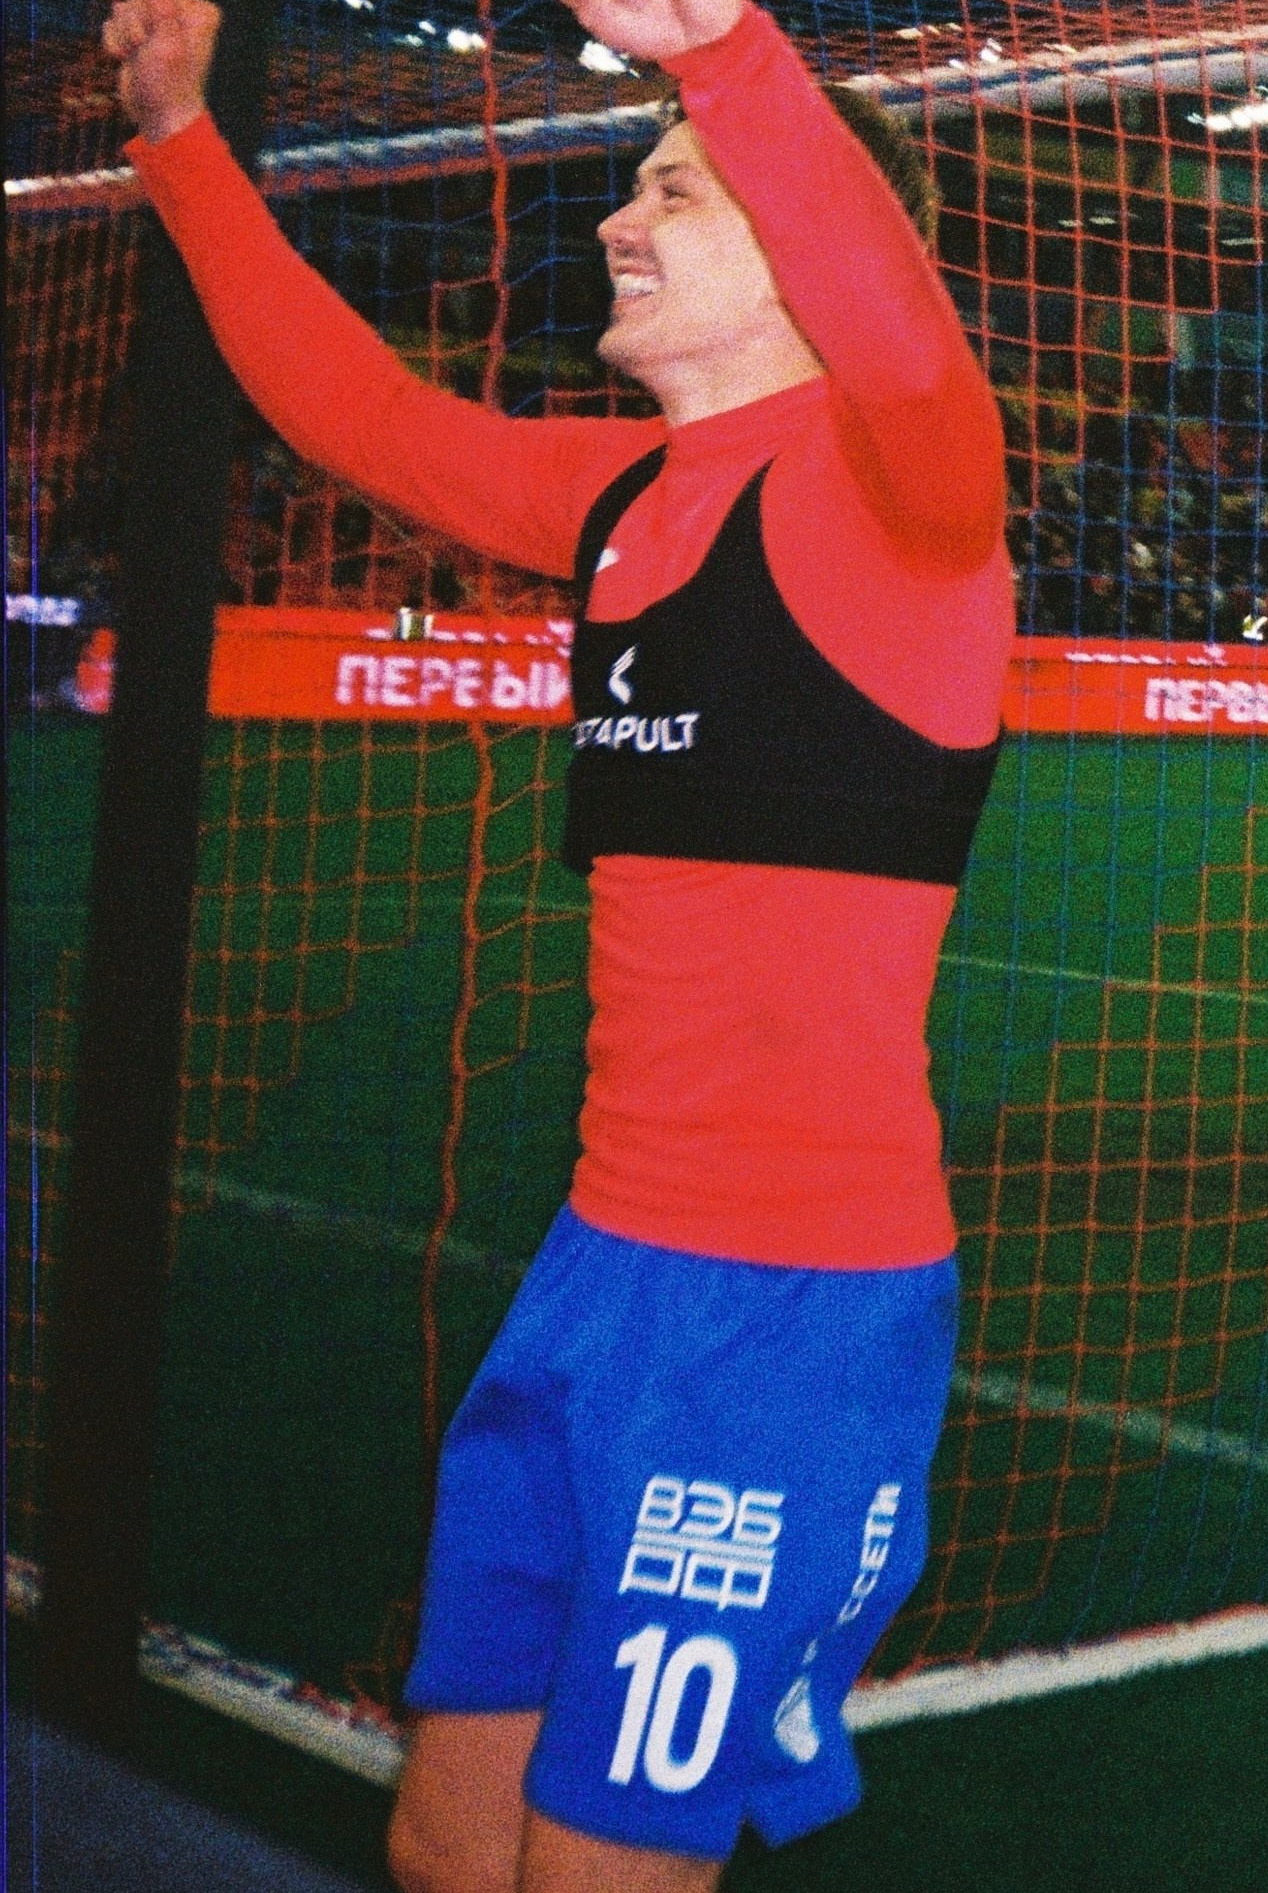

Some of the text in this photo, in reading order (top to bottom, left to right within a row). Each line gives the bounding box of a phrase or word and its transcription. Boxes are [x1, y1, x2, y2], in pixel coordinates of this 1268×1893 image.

[572, 710, 701, 753] TAPULT
[636, 1473, 786, 1545] ВЭБ
[617, 1542, 777, 1613] РФ
[606, 1621, 740, 1794] 10
